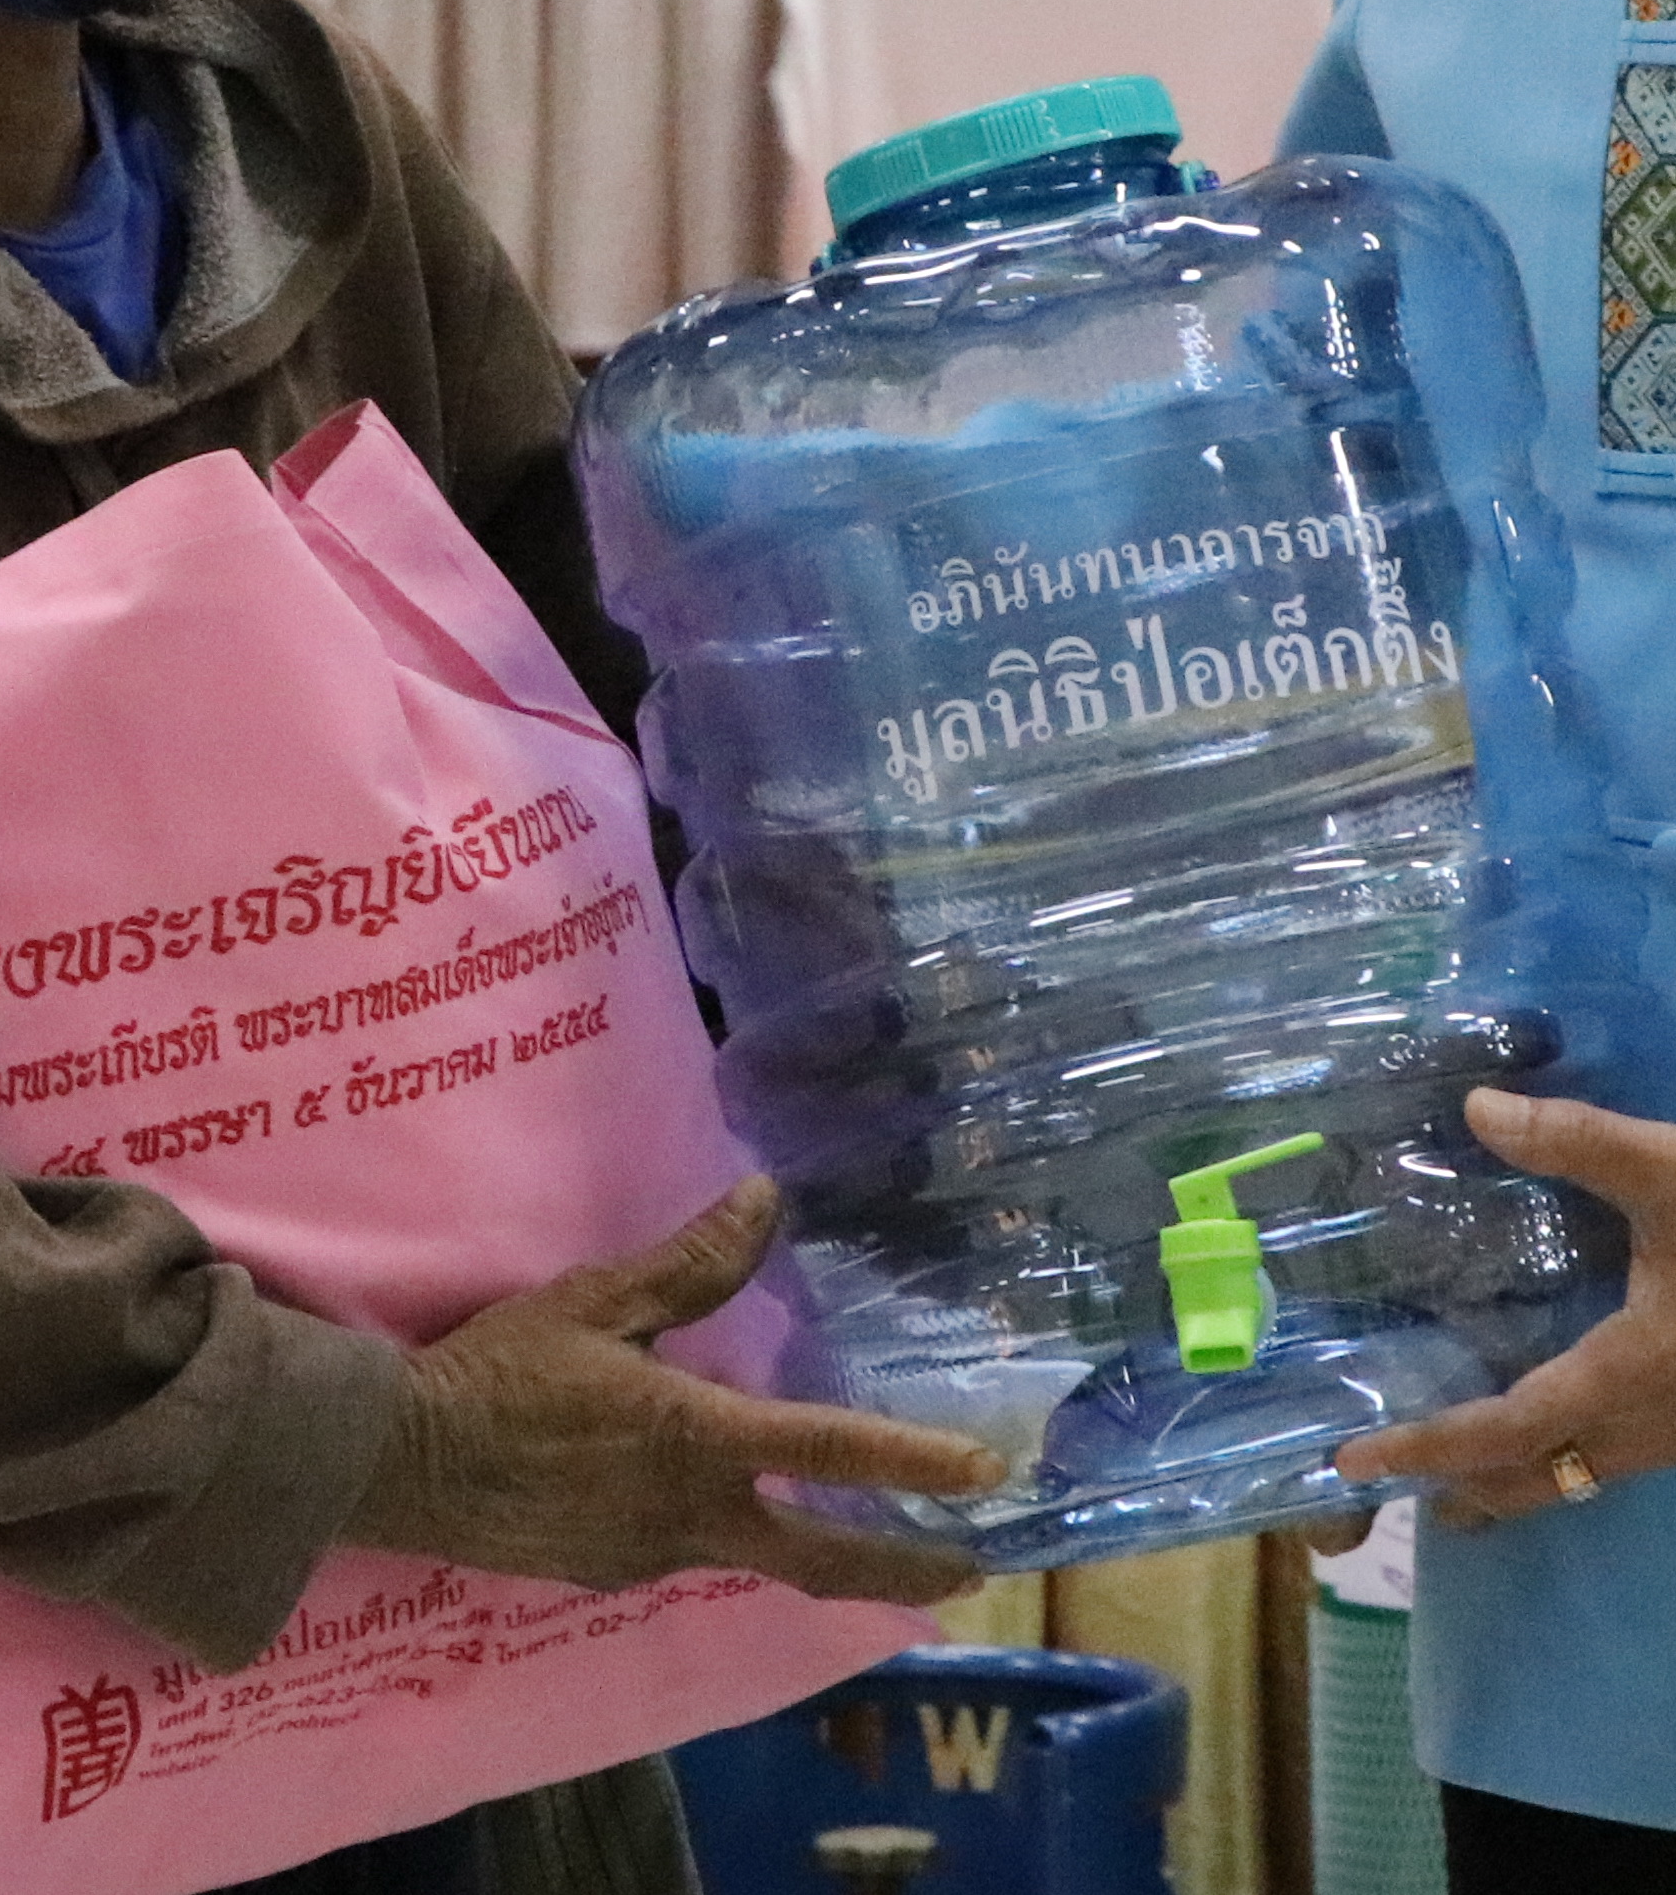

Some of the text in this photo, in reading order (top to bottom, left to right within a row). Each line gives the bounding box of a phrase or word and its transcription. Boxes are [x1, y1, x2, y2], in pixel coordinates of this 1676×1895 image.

[907, 508, 1388, 634] อภินันทนาการจาก
[877, 556, 1462, 804] มูลนิธิป่อเต็กตึ๊ง
[122, 1100, 272, 1165] พรรษา
[293, 1085, 331, 1128] ๕
[345, 1037, 498, 1116] ธันวาคม
[510, 993, 611, 1062] ๒๕๕๔
[218, 1680, 275, 1713] 326
